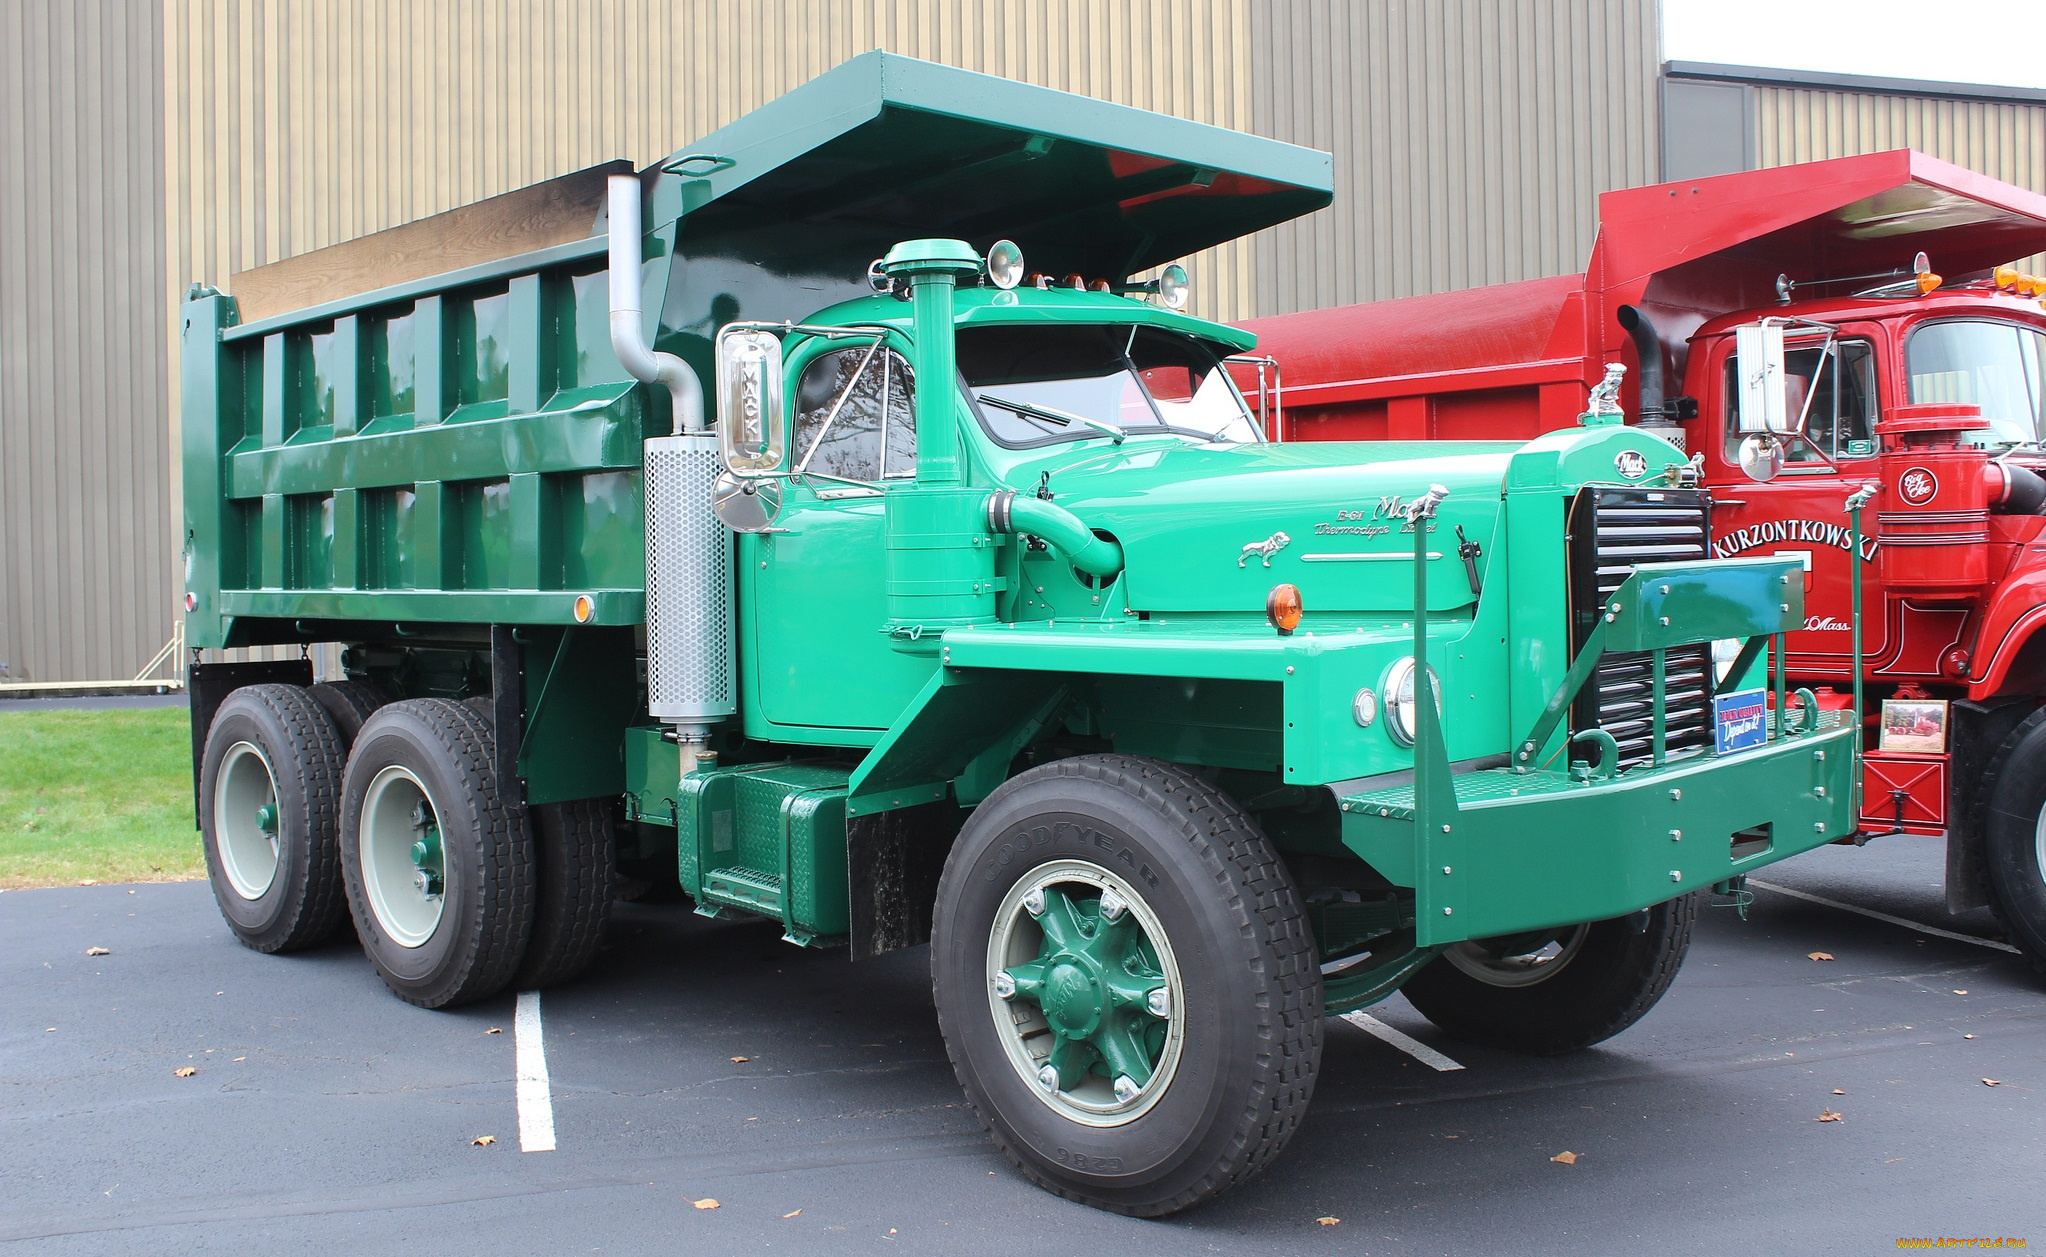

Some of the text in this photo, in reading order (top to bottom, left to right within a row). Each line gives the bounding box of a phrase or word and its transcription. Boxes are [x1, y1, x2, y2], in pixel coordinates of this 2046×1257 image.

[742, 367, 758, 434] MACK
[1619, 453, 1644, 472] Mack
[1904, 473, 1924, 487] Big
[1907, 479, 1932, 498] Joe
[1371, 496, 1438, 521] Ma
[1314, 522, 1390, 541] Thermodyne
[985, 822, 1160, 892] GOODYEAR
